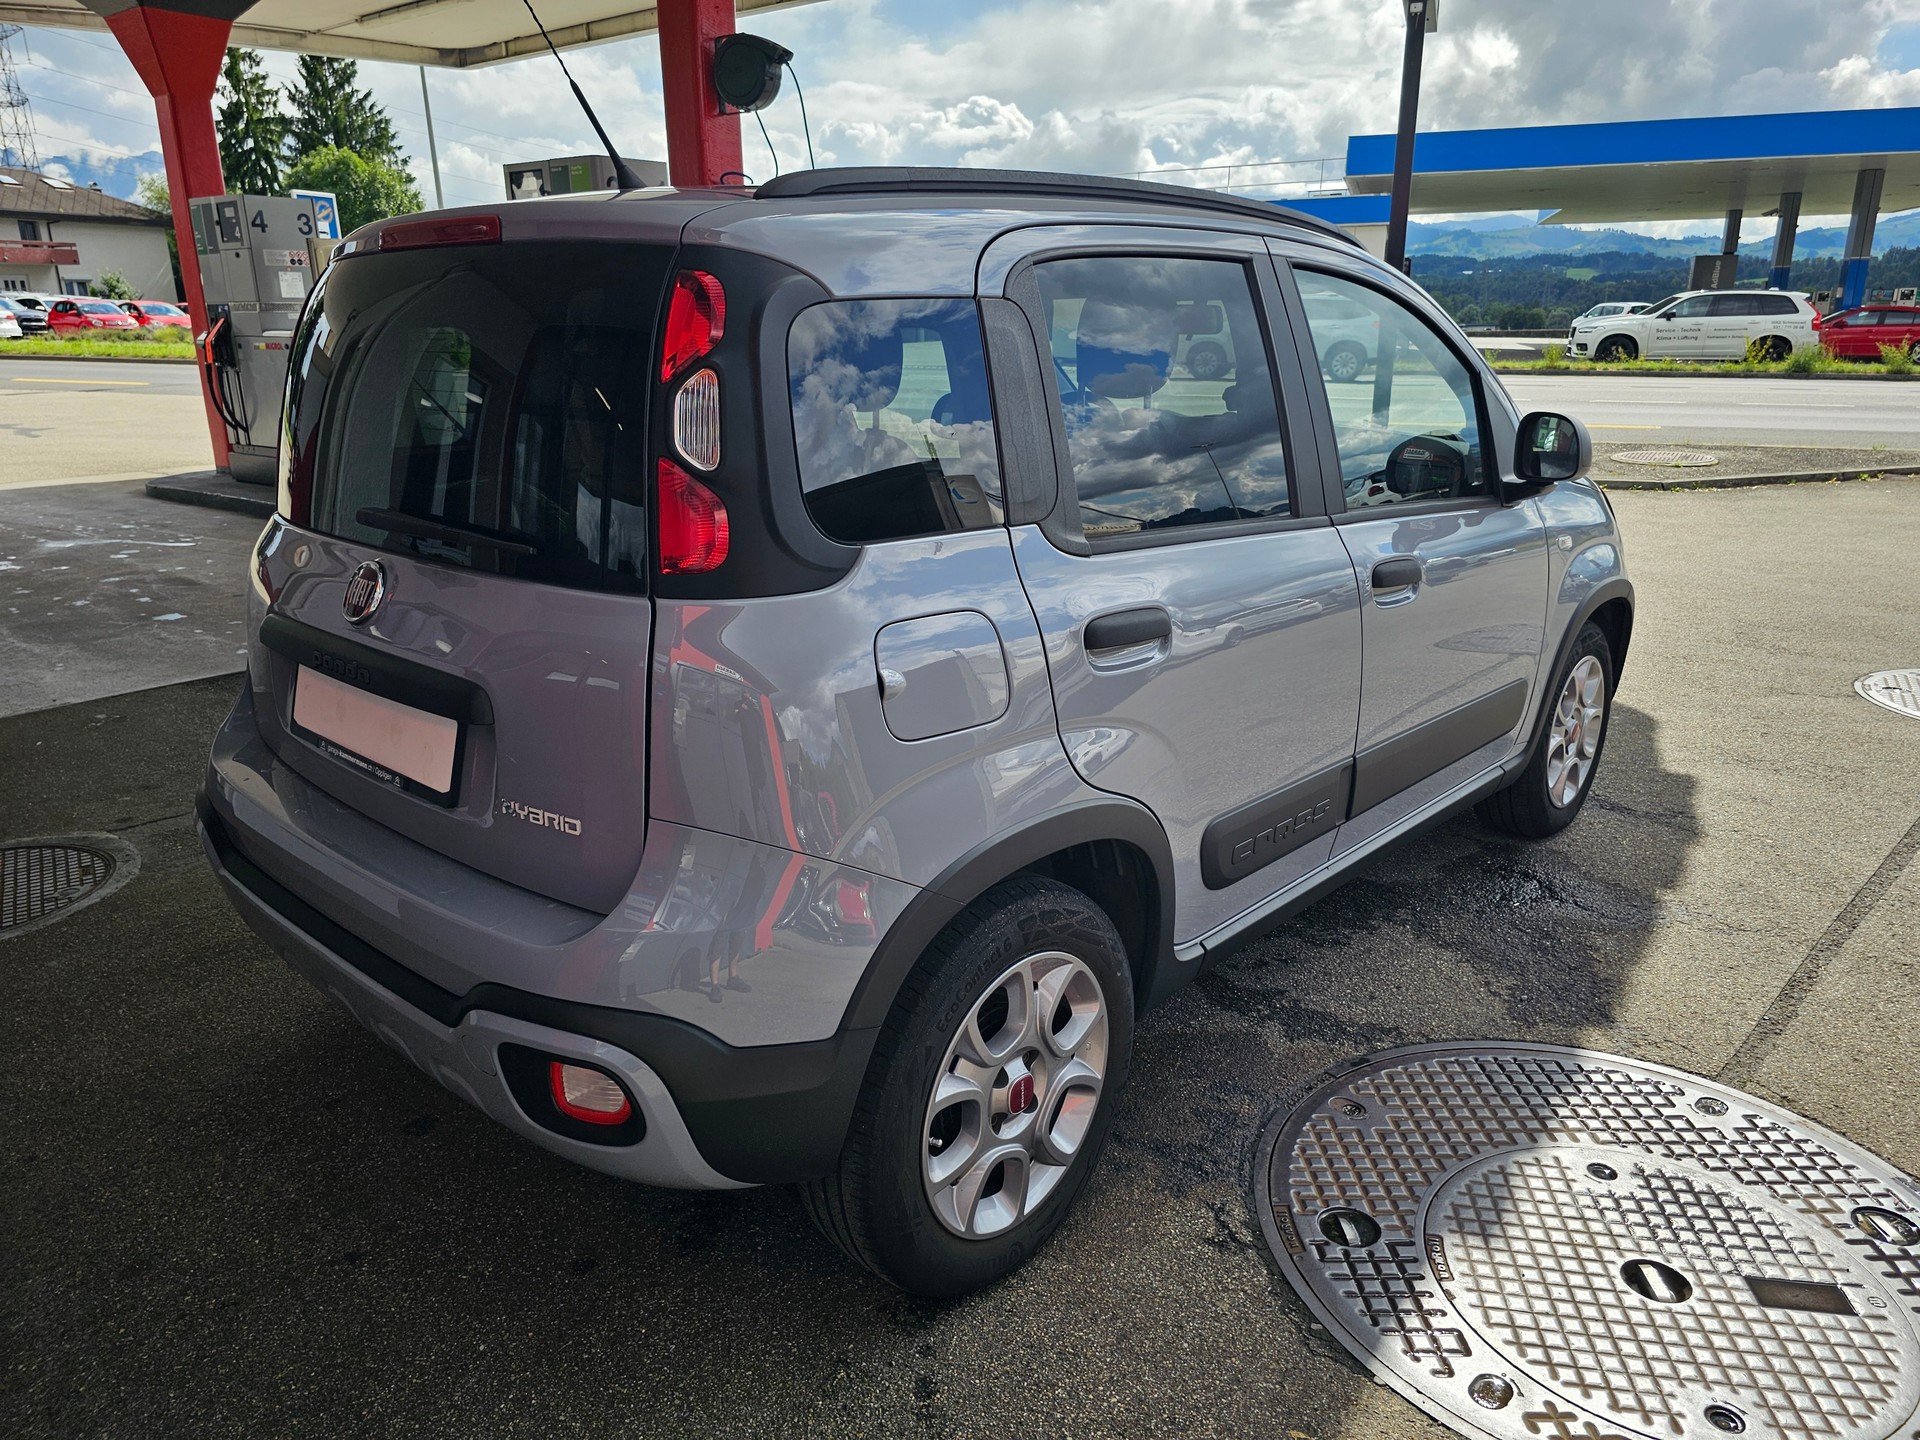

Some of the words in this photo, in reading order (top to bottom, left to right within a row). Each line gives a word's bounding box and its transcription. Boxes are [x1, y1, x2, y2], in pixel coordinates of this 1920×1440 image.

[251, 209, 268, 233] 4
[296, 213, 313, 236] 3
[1711, 260, 1721, 289] AdBlue
[346, 577, 375, 607] FIAT
[312, 649, 370, 685] panda
